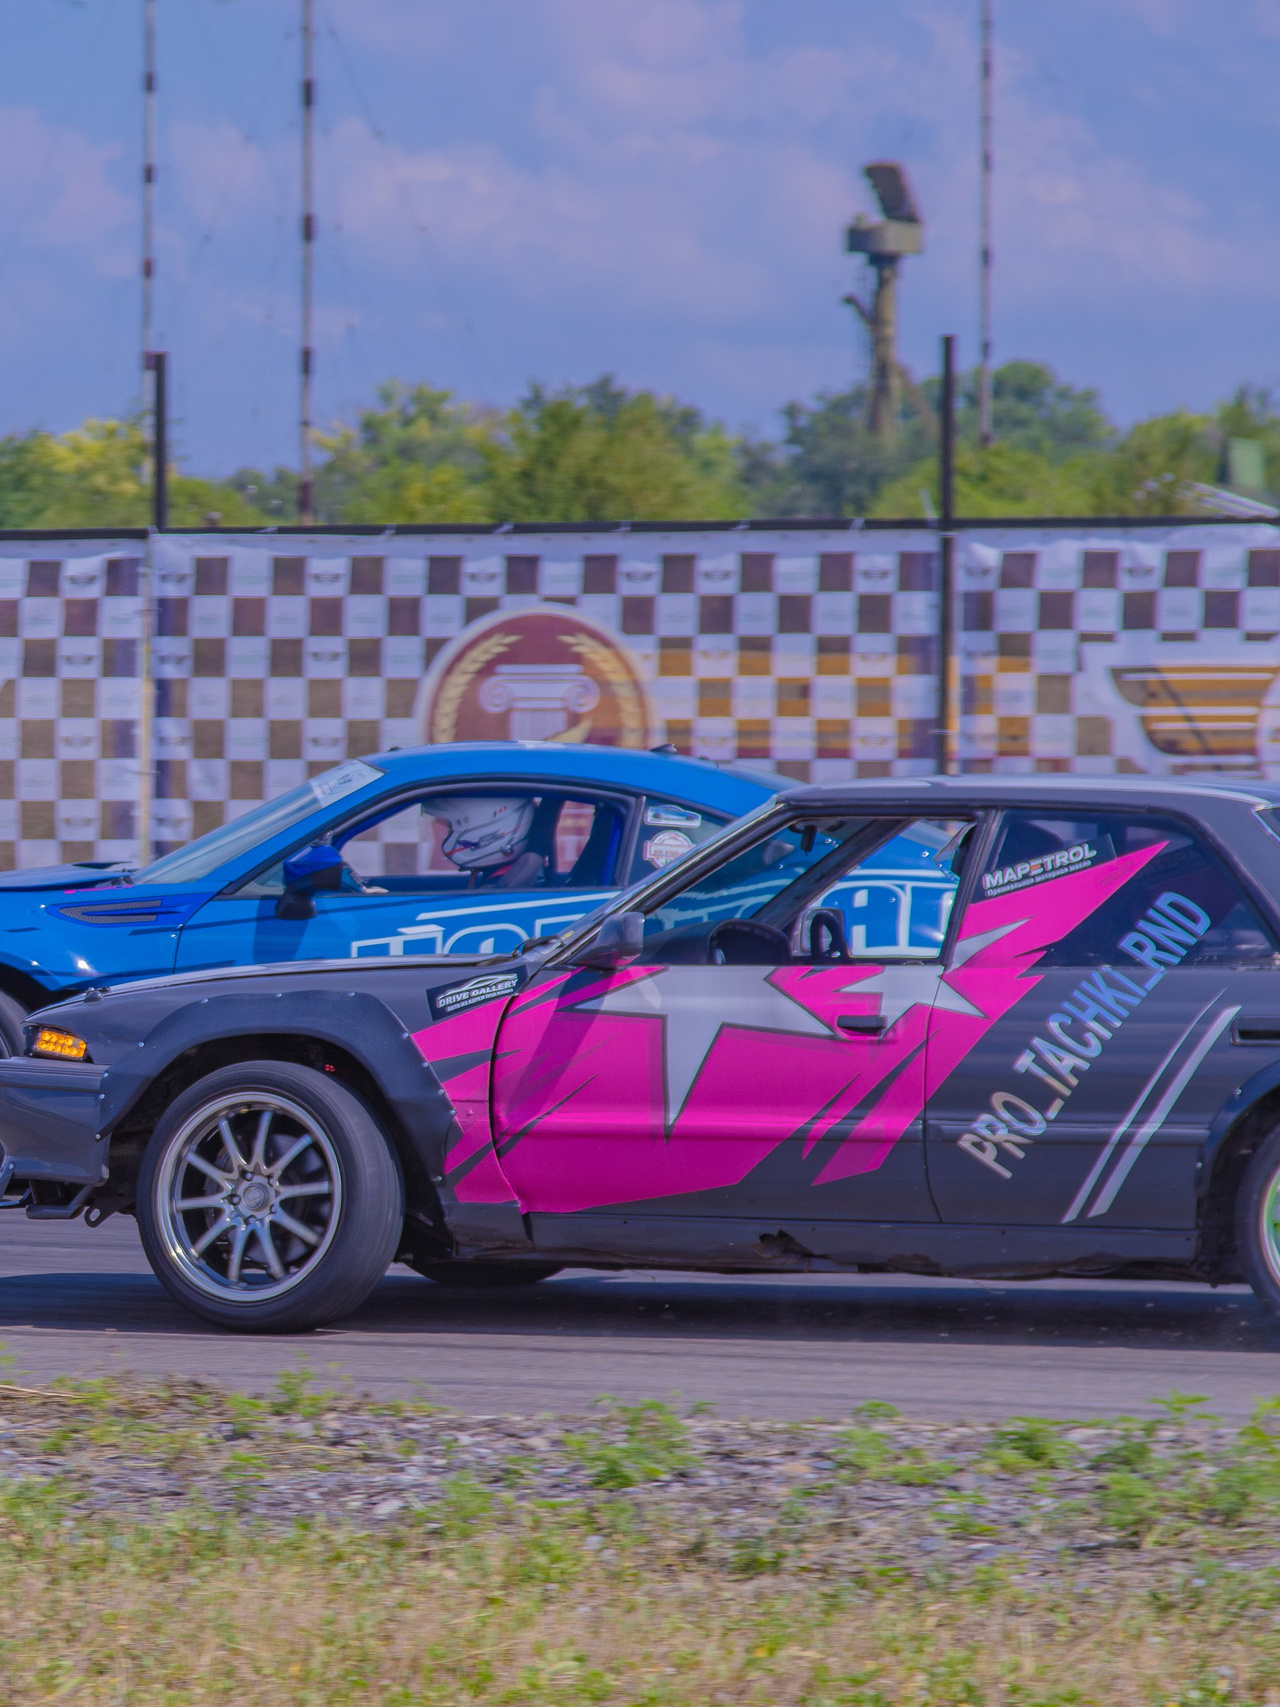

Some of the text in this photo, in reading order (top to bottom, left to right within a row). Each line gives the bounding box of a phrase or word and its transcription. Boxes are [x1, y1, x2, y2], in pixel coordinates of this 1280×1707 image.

[982, 843, 1097, 889] MAPETROL
[437, 992, 470, 1008] DRIVE
[470, 979, 518, 996] GALLERY
